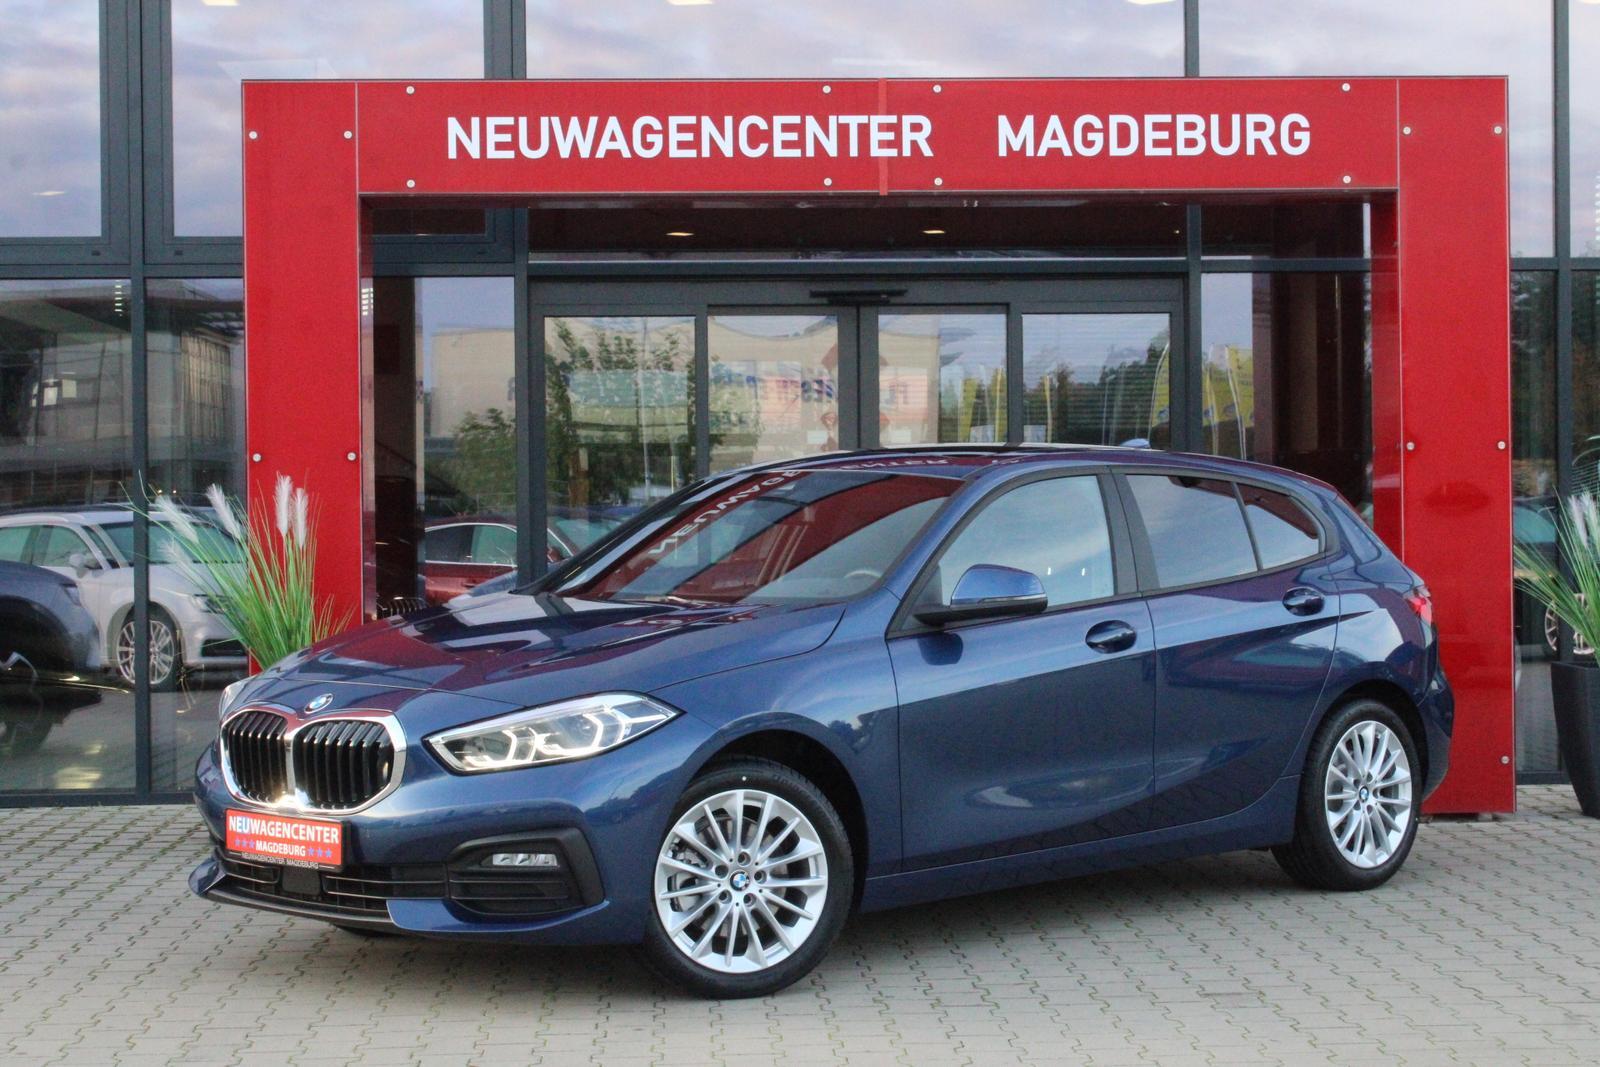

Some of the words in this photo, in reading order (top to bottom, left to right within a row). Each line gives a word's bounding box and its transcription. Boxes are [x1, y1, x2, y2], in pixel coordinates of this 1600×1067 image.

[447, 114, 934, 160] NEUWAGENCENTER
[997, 112, 1311, 158] MAGDEBURG
[229, 815, 339, 844] NEUWAGENCENTER
[255, 839, 306, 857] MAGDEBURG
